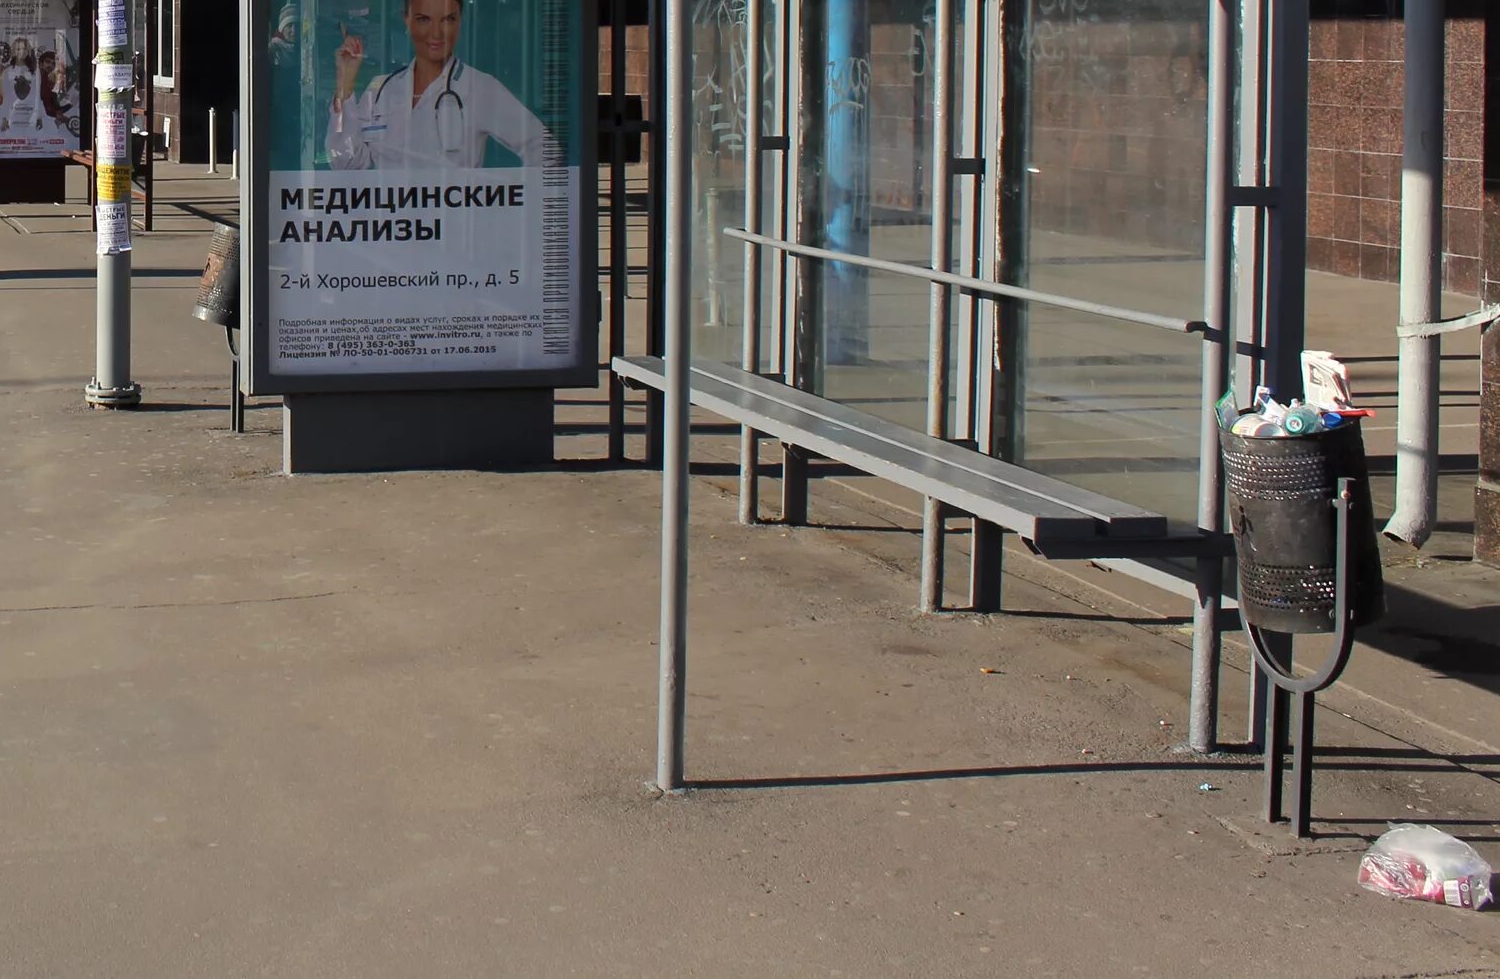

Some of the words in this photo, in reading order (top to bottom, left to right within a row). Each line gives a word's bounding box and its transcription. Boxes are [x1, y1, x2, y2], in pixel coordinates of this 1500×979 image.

[280, 185, 525, 213] МЕДИЦИНСКИЕ
[279, 219, 442, 244] АНАЛИЗЫ
[280, 273, 310, 289] 2-й
[317, 272, 440, 292] Хорошевский
[446, 273, 480, 290] пр.,
[485, 271, 503, 288] д.
[508, 270, 520, 285] 5
[279, 318, 326, 328] Подробная
[330, 317, 384, 327] информация
[395, 317, 420, 325] видах
[279, 327, 319, 335] оказания
[373, 325, 407, 333] адресах
[279, 335, 311, 343] офисов
[315, 335, 360, 343] приведена
[377, 333, 400, 341] сайте
[410, 331, 484, 339] www.invitro.ru,
[279, 343, 325, 352] телефону:
[337, 342, 364, 350] (495)
[366, 340, 416, 348] 363-0-363
[279, 351, 326, 359] Лицензия
[343, 348, 428, 357] ЛО-50-01-006731
[444, 346, 496, 354] 17.06.2015
